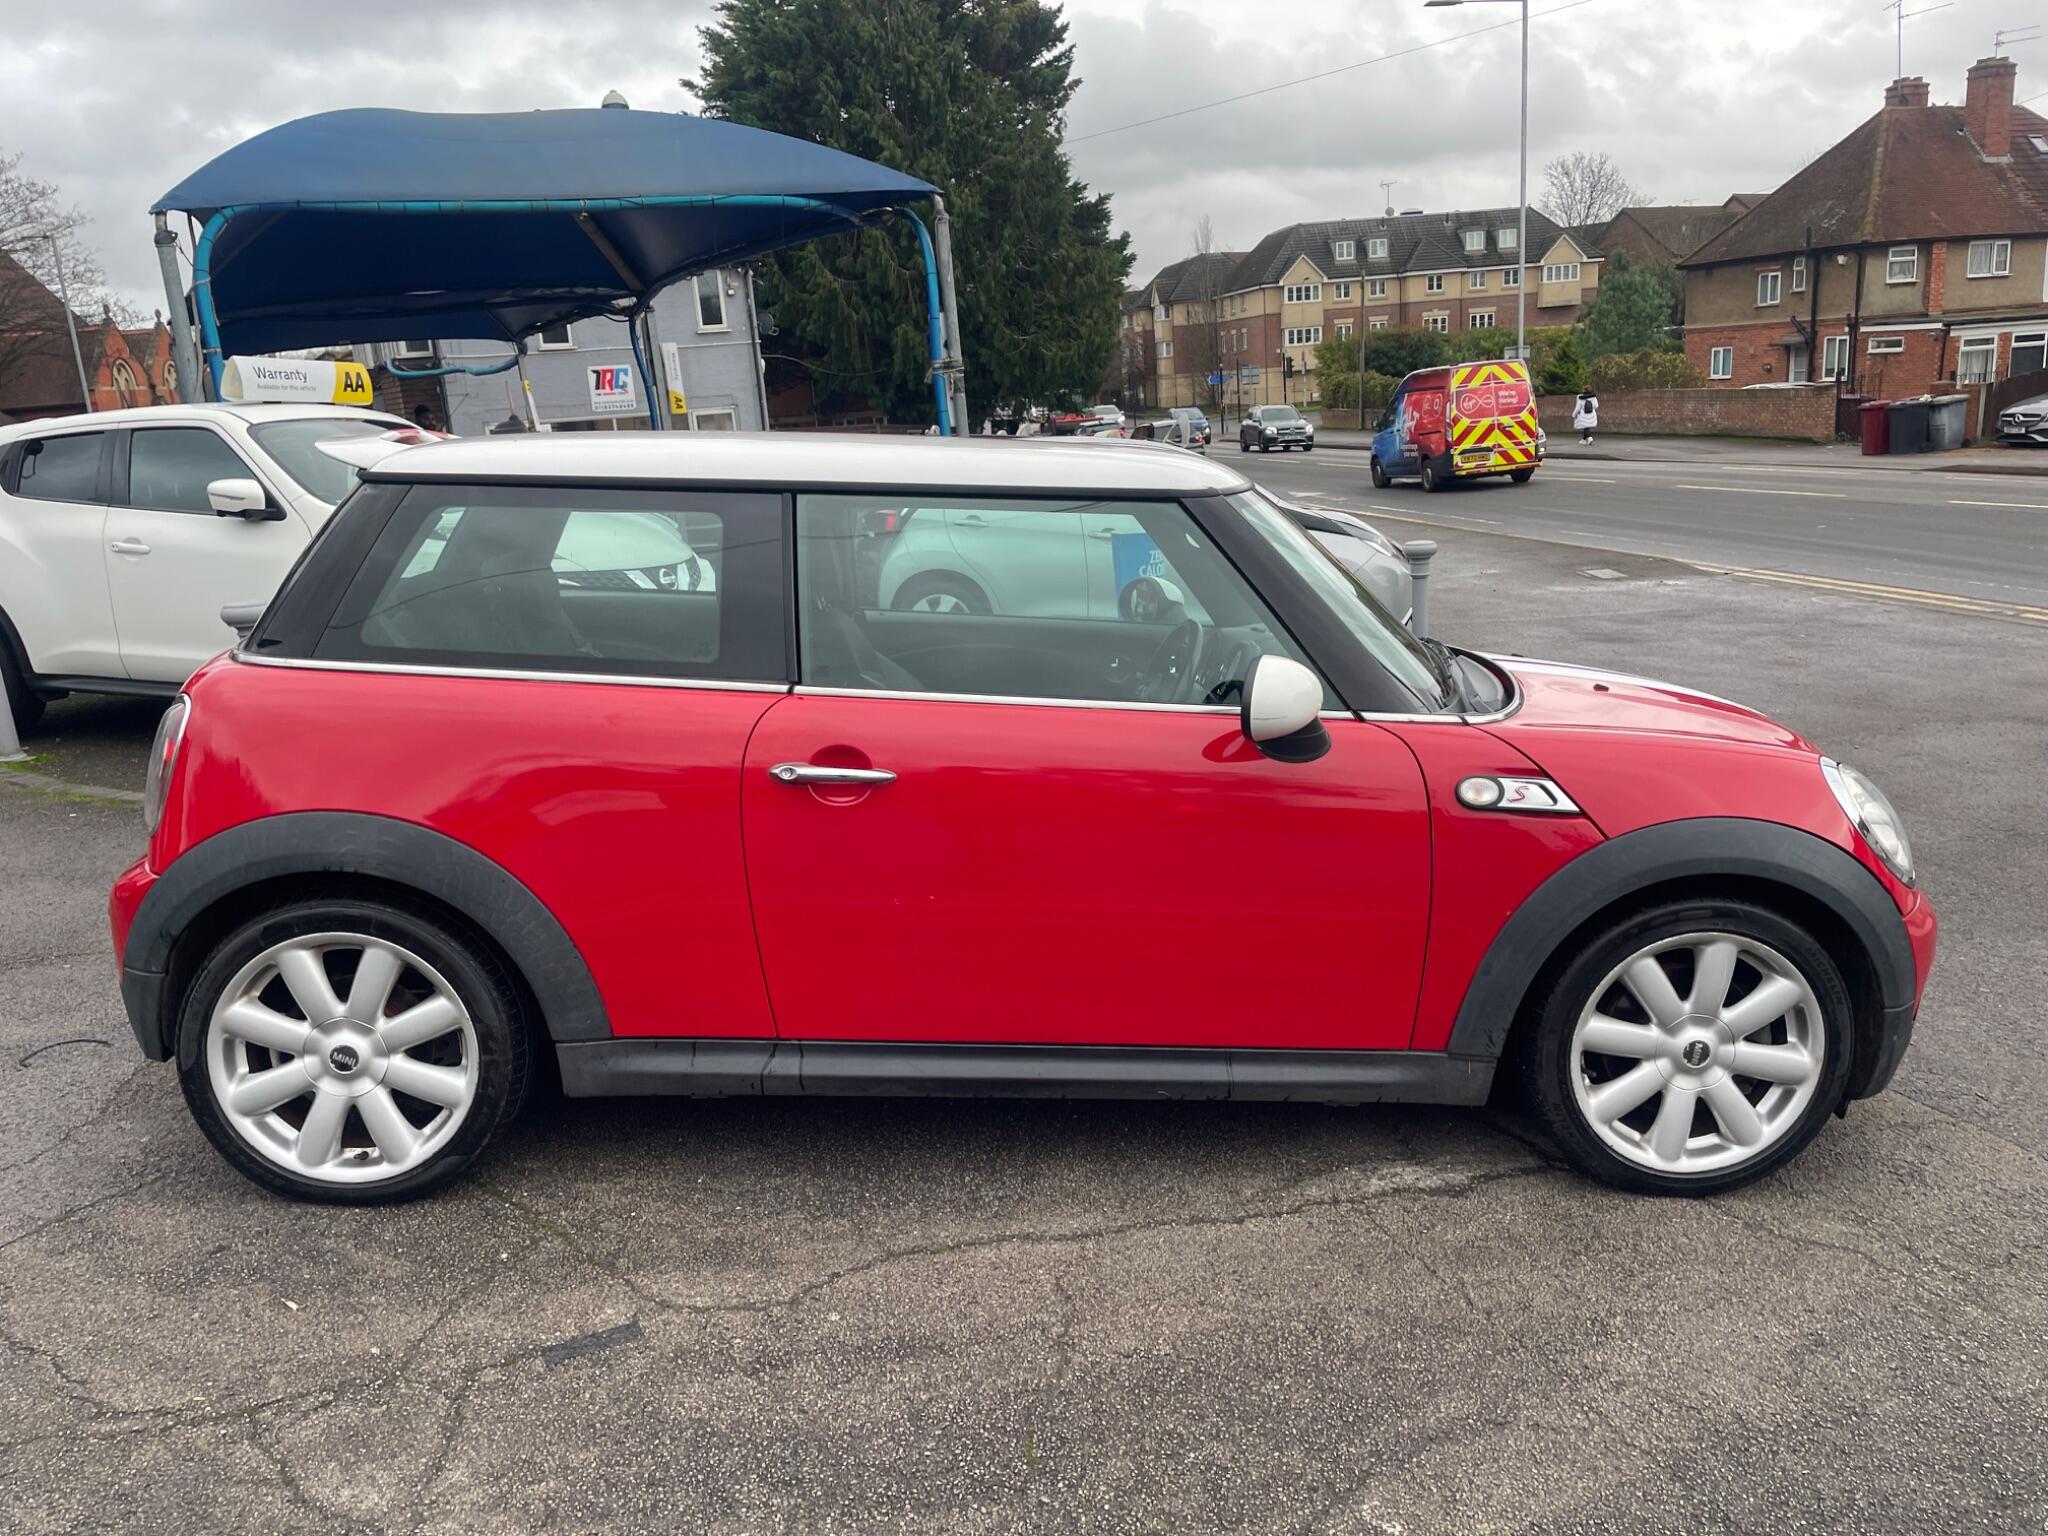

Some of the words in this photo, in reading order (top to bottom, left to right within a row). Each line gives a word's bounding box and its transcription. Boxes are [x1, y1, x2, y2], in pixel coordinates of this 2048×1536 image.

[253, 366, 308, 383] Warranty
[343, 371, 365, 393] AA
[674, 395, 683, 409] AA
[1506, 785, 1530, 803] S
[1805, 948, 1845, 1006] MICHELIN
[332, 1051, 357, 1066] MINI
